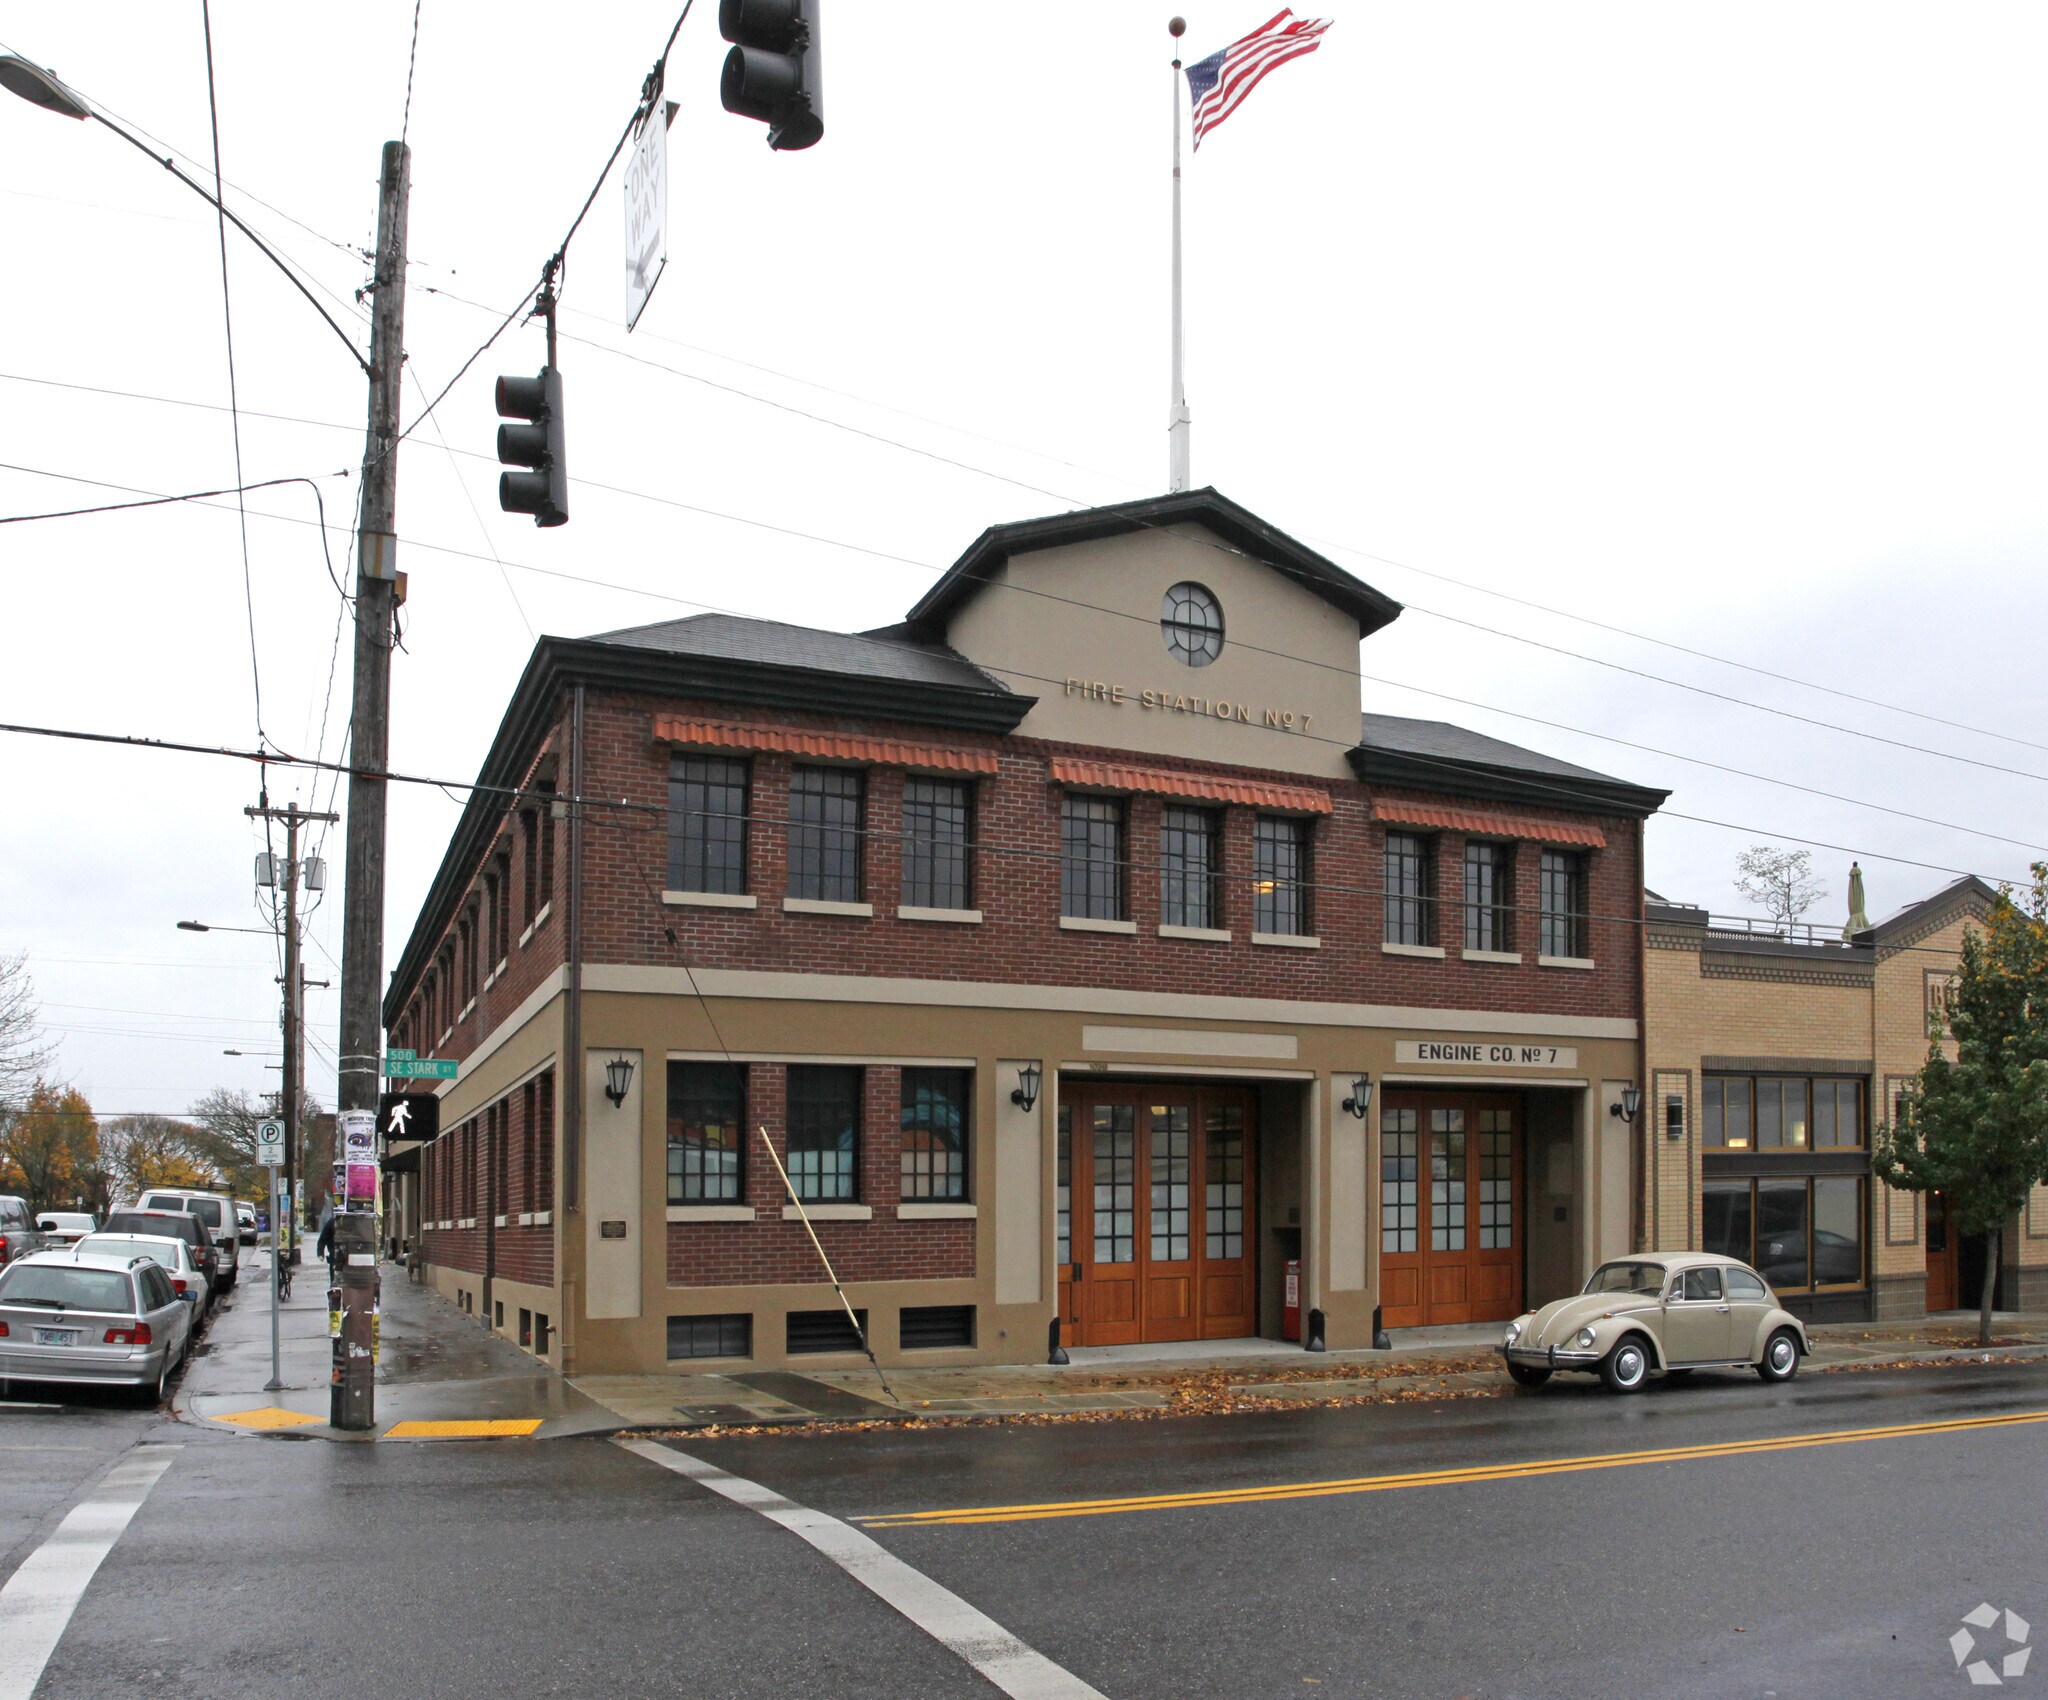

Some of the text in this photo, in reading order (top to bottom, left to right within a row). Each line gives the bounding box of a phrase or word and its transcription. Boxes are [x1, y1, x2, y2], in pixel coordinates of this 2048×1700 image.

[631, 125, 659, 205] ONE
[631, 167, 660, 249] WAY
[1065, 677, 1125, 704] FIRE
[1141, 689, 1251, 722] STATION
[1301, 713, 1314, 732] 7
[390, 1050, 413, 1061] 500
[1418, 1043, 1483, 1061] ENGINE
[1489, 1046, 1516, 1062] CO.
[1548, 1048, 1557, 1063] 7
[390, 1061, 452, 1075] SE STARK ST
[266, 1127, 276, 1140] P
